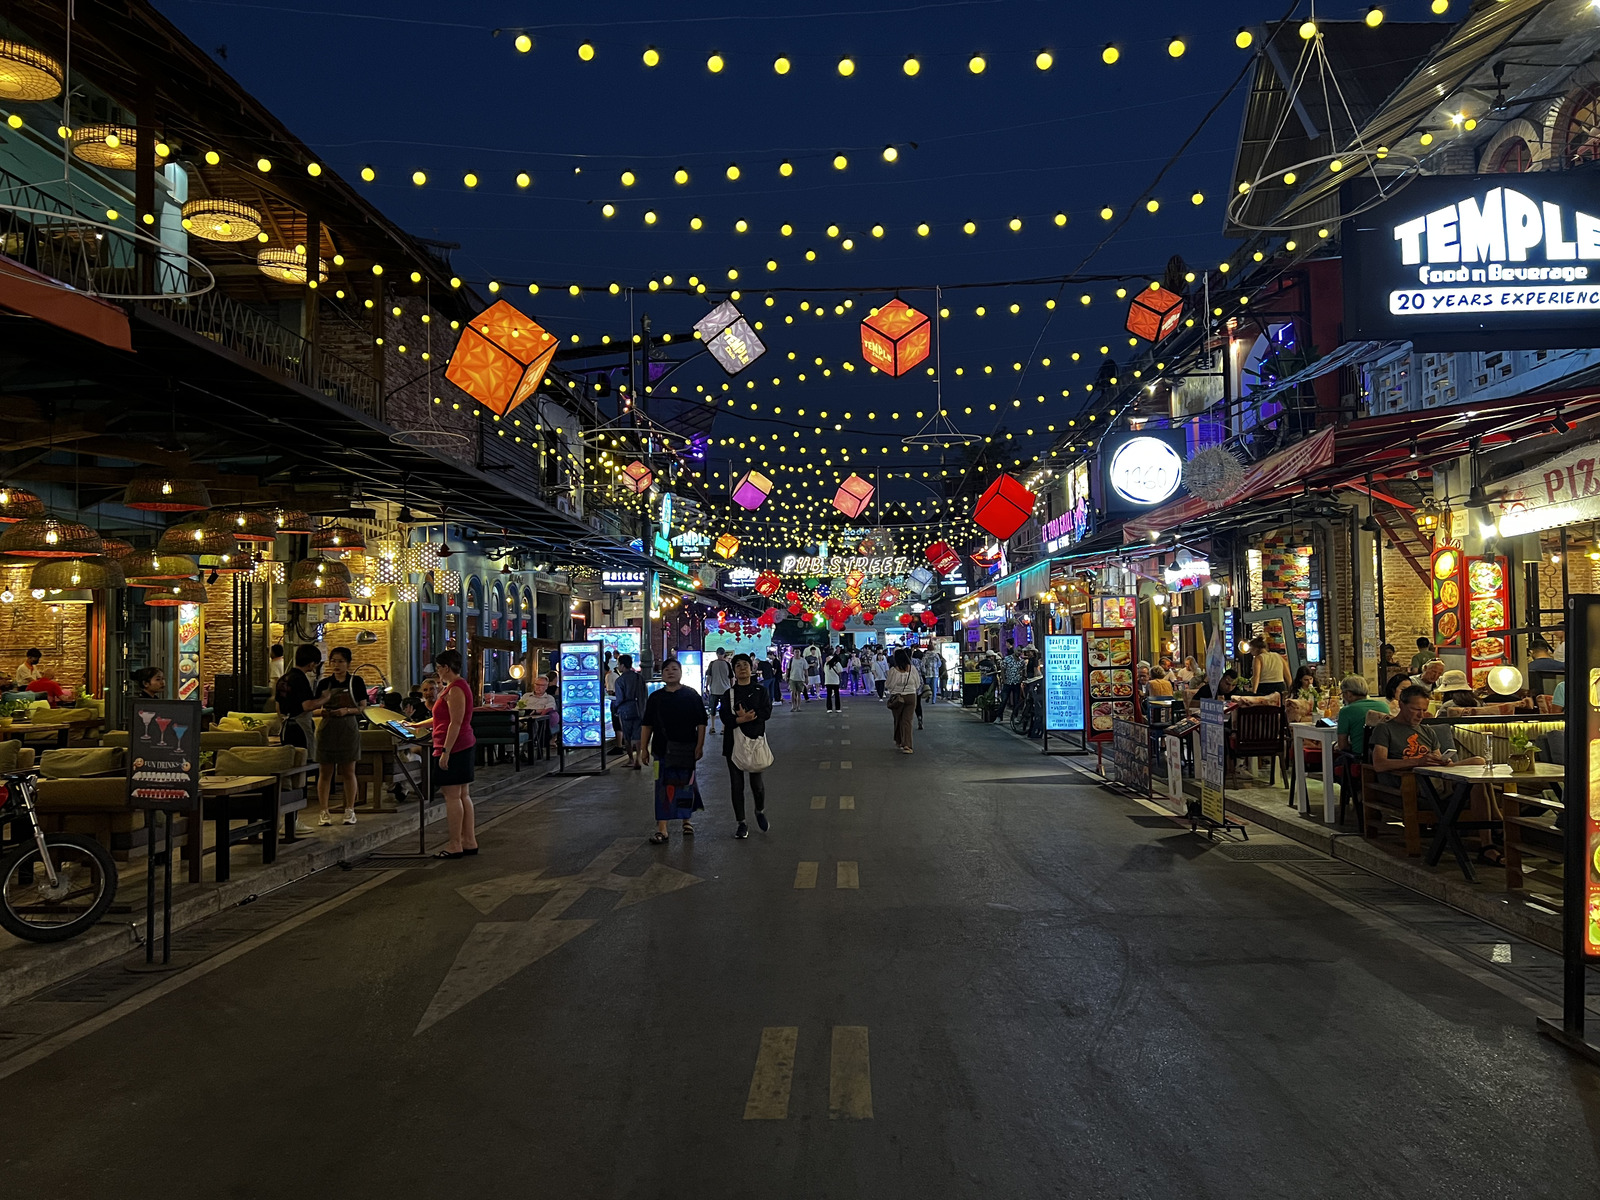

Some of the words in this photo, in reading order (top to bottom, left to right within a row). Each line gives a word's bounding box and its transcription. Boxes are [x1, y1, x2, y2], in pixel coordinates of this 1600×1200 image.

[1394, 187, 1600, 265] TEMPLE
[1488, 263, 1588, 282] Beverage
[1397, 293, 1425, 310] 20
[1432, 293, 1493, 308] YEARS
[1125, 465, 1167, 490] 1960
[783, 555, 824, 574] PUB
[828, 556, 907, 575] STREET
[602, 571, 645, 581] MASSAGE
[340, 601, 395, 622] AMILY
[145, 761, 156, 769] FUN
[157, 761, 180, 769] DRINKS
